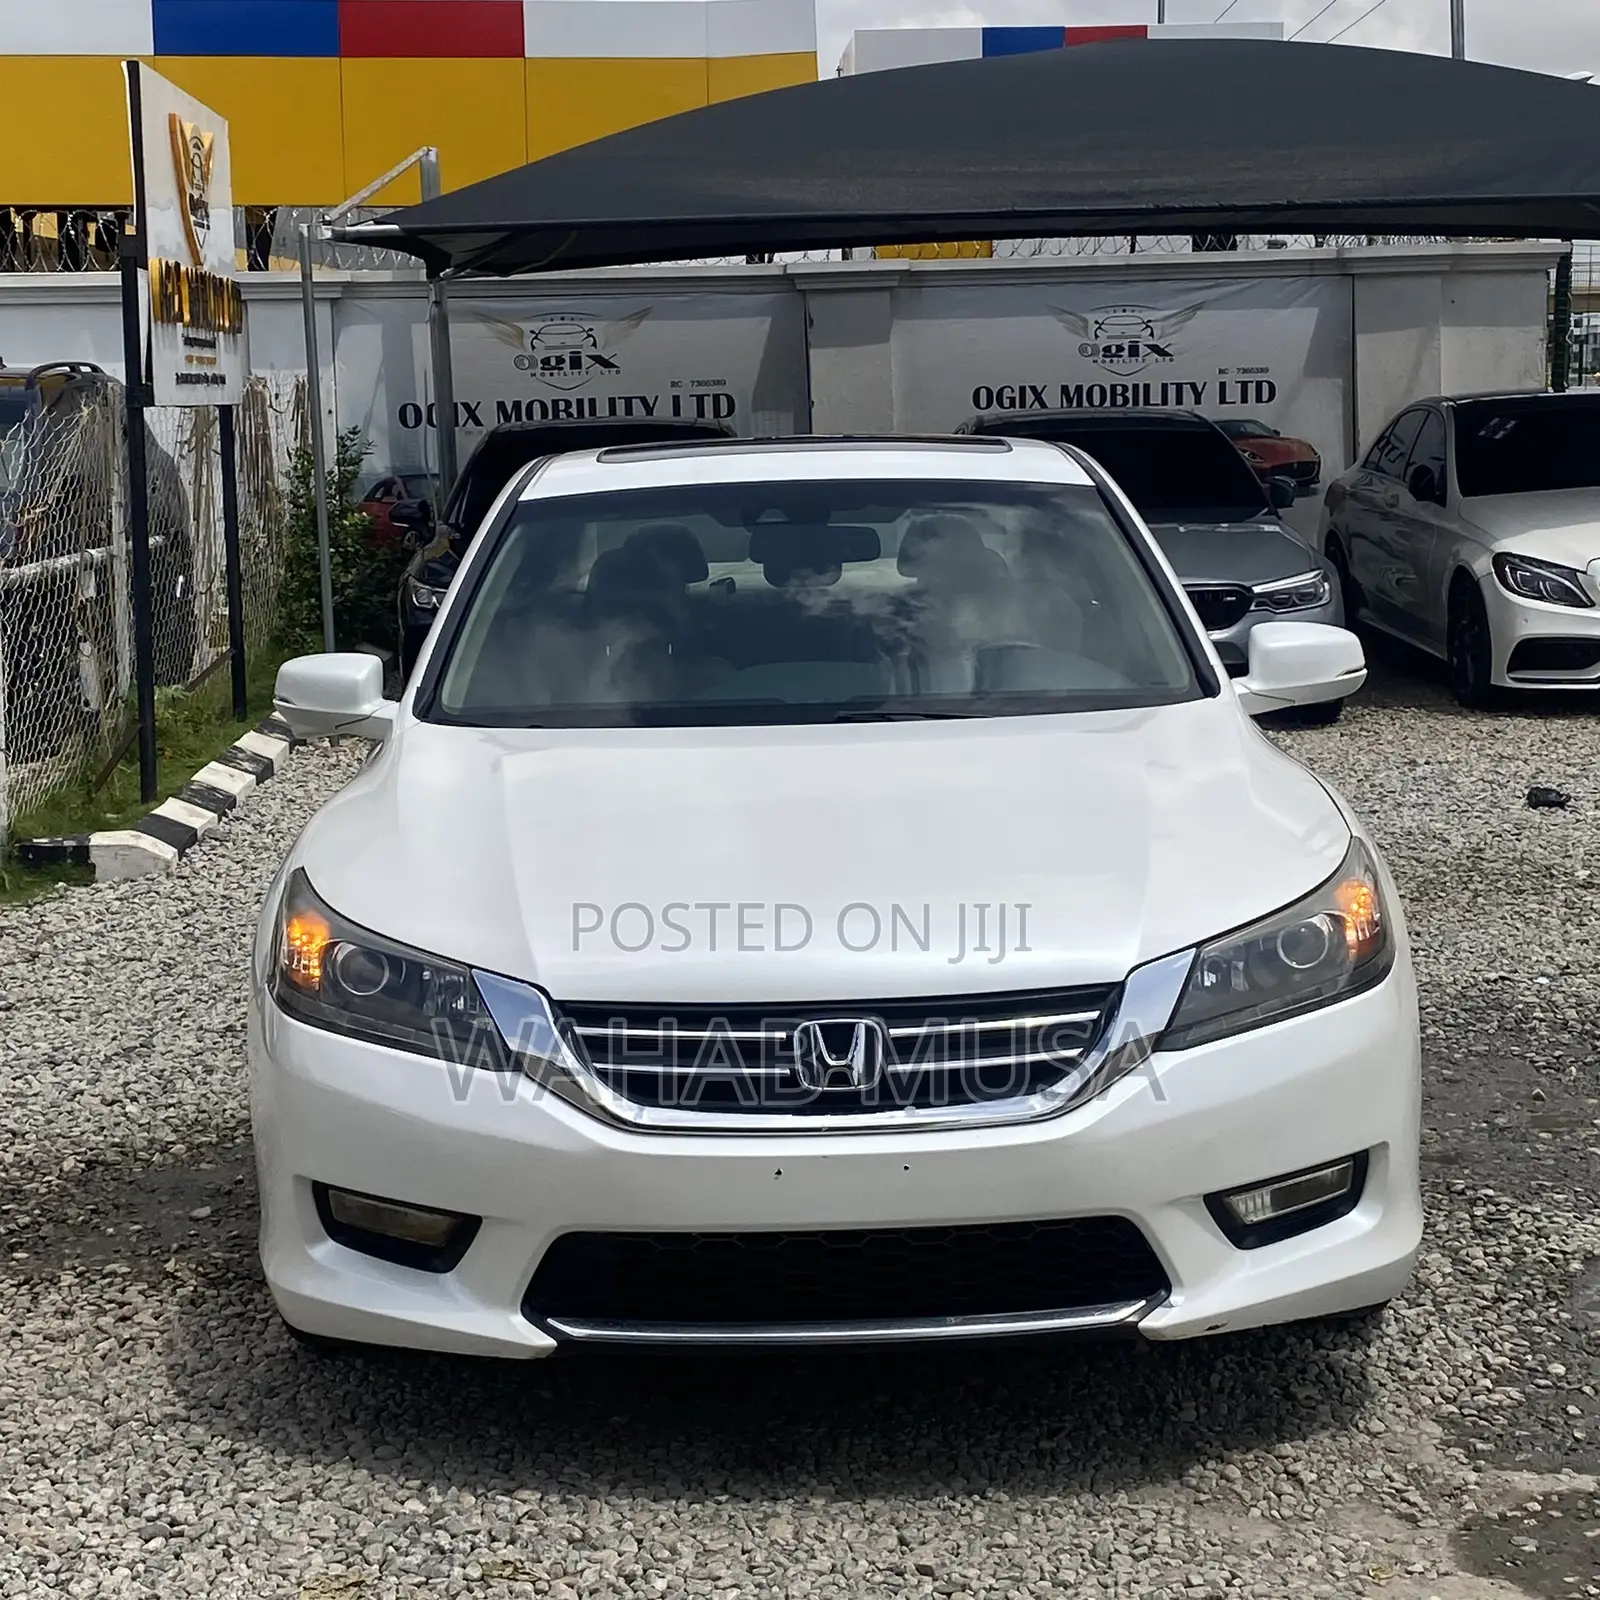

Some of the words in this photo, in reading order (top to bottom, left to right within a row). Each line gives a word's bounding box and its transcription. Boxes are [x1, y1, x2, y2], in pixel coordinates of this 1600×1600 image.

[670, 380, 683, 388] RC
[972, 384, 1049, 410] OGIX
[1060, 381, 1207, 409] MOBILITY
[1218, 379, 1277, 405] LTD
[496, 395, 660, 424] MOBILITY
